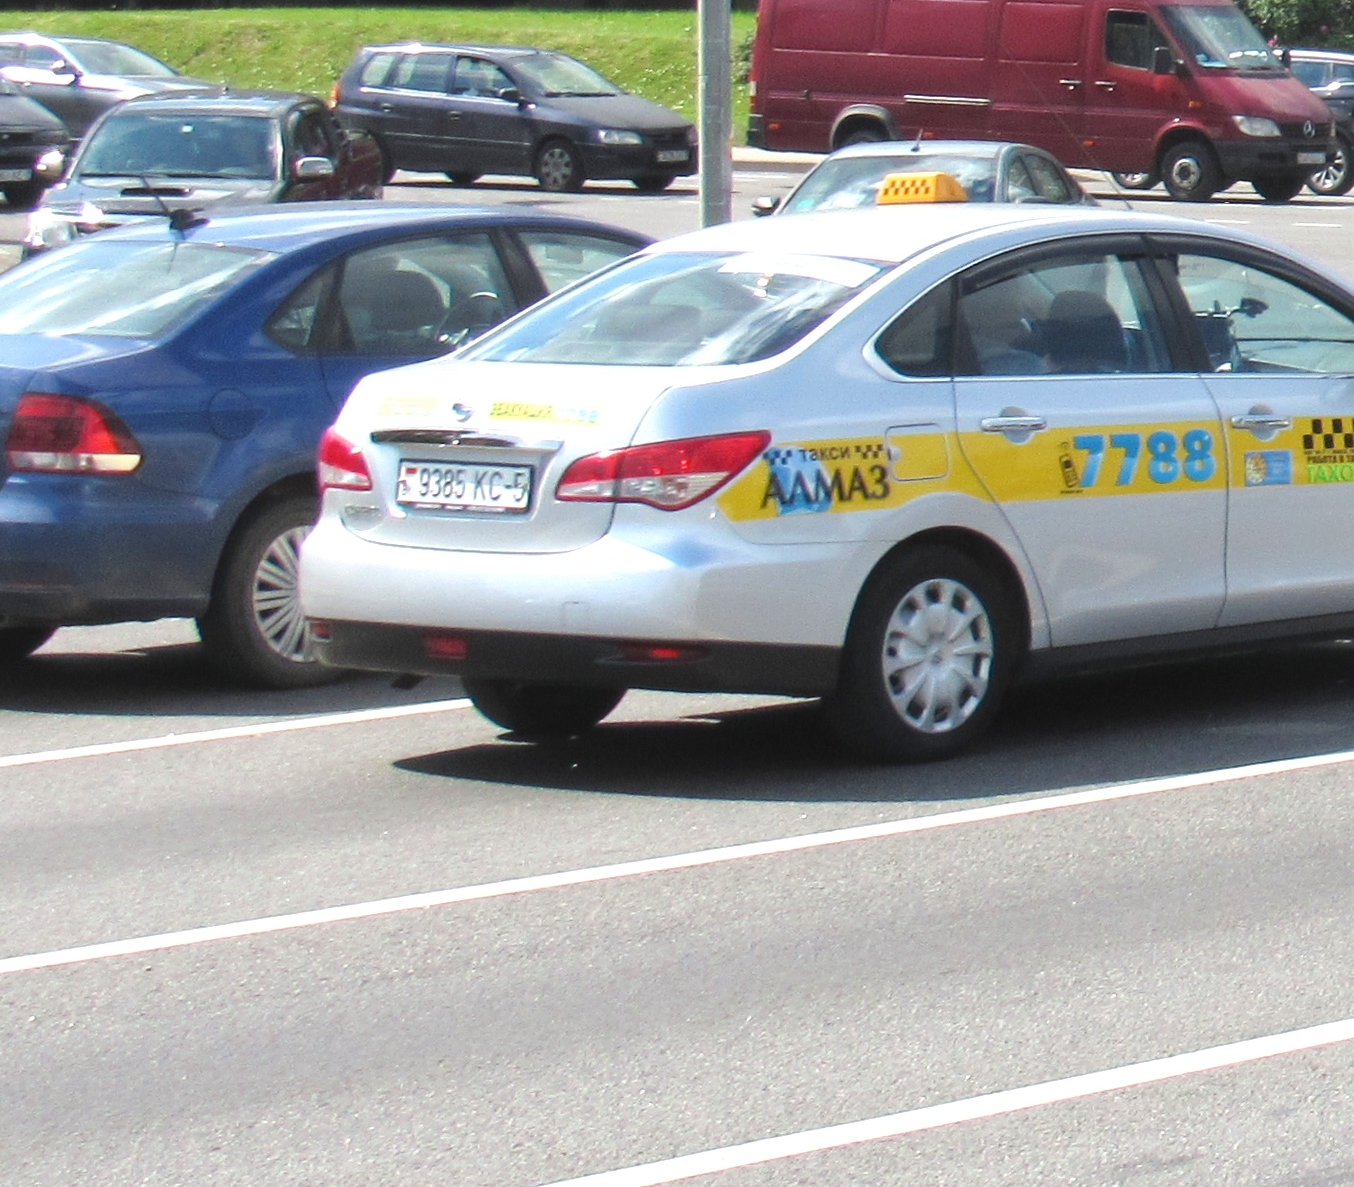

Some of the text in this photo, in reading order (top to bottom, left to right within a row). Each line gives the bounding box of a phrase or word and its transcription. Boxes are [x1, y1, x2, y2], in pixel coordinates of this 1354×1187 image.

[1073, 429, 1217, 487] 7788
[420, 467, 466, 498] 9385
[760, 464, 891, 509] АЛМАЗ
